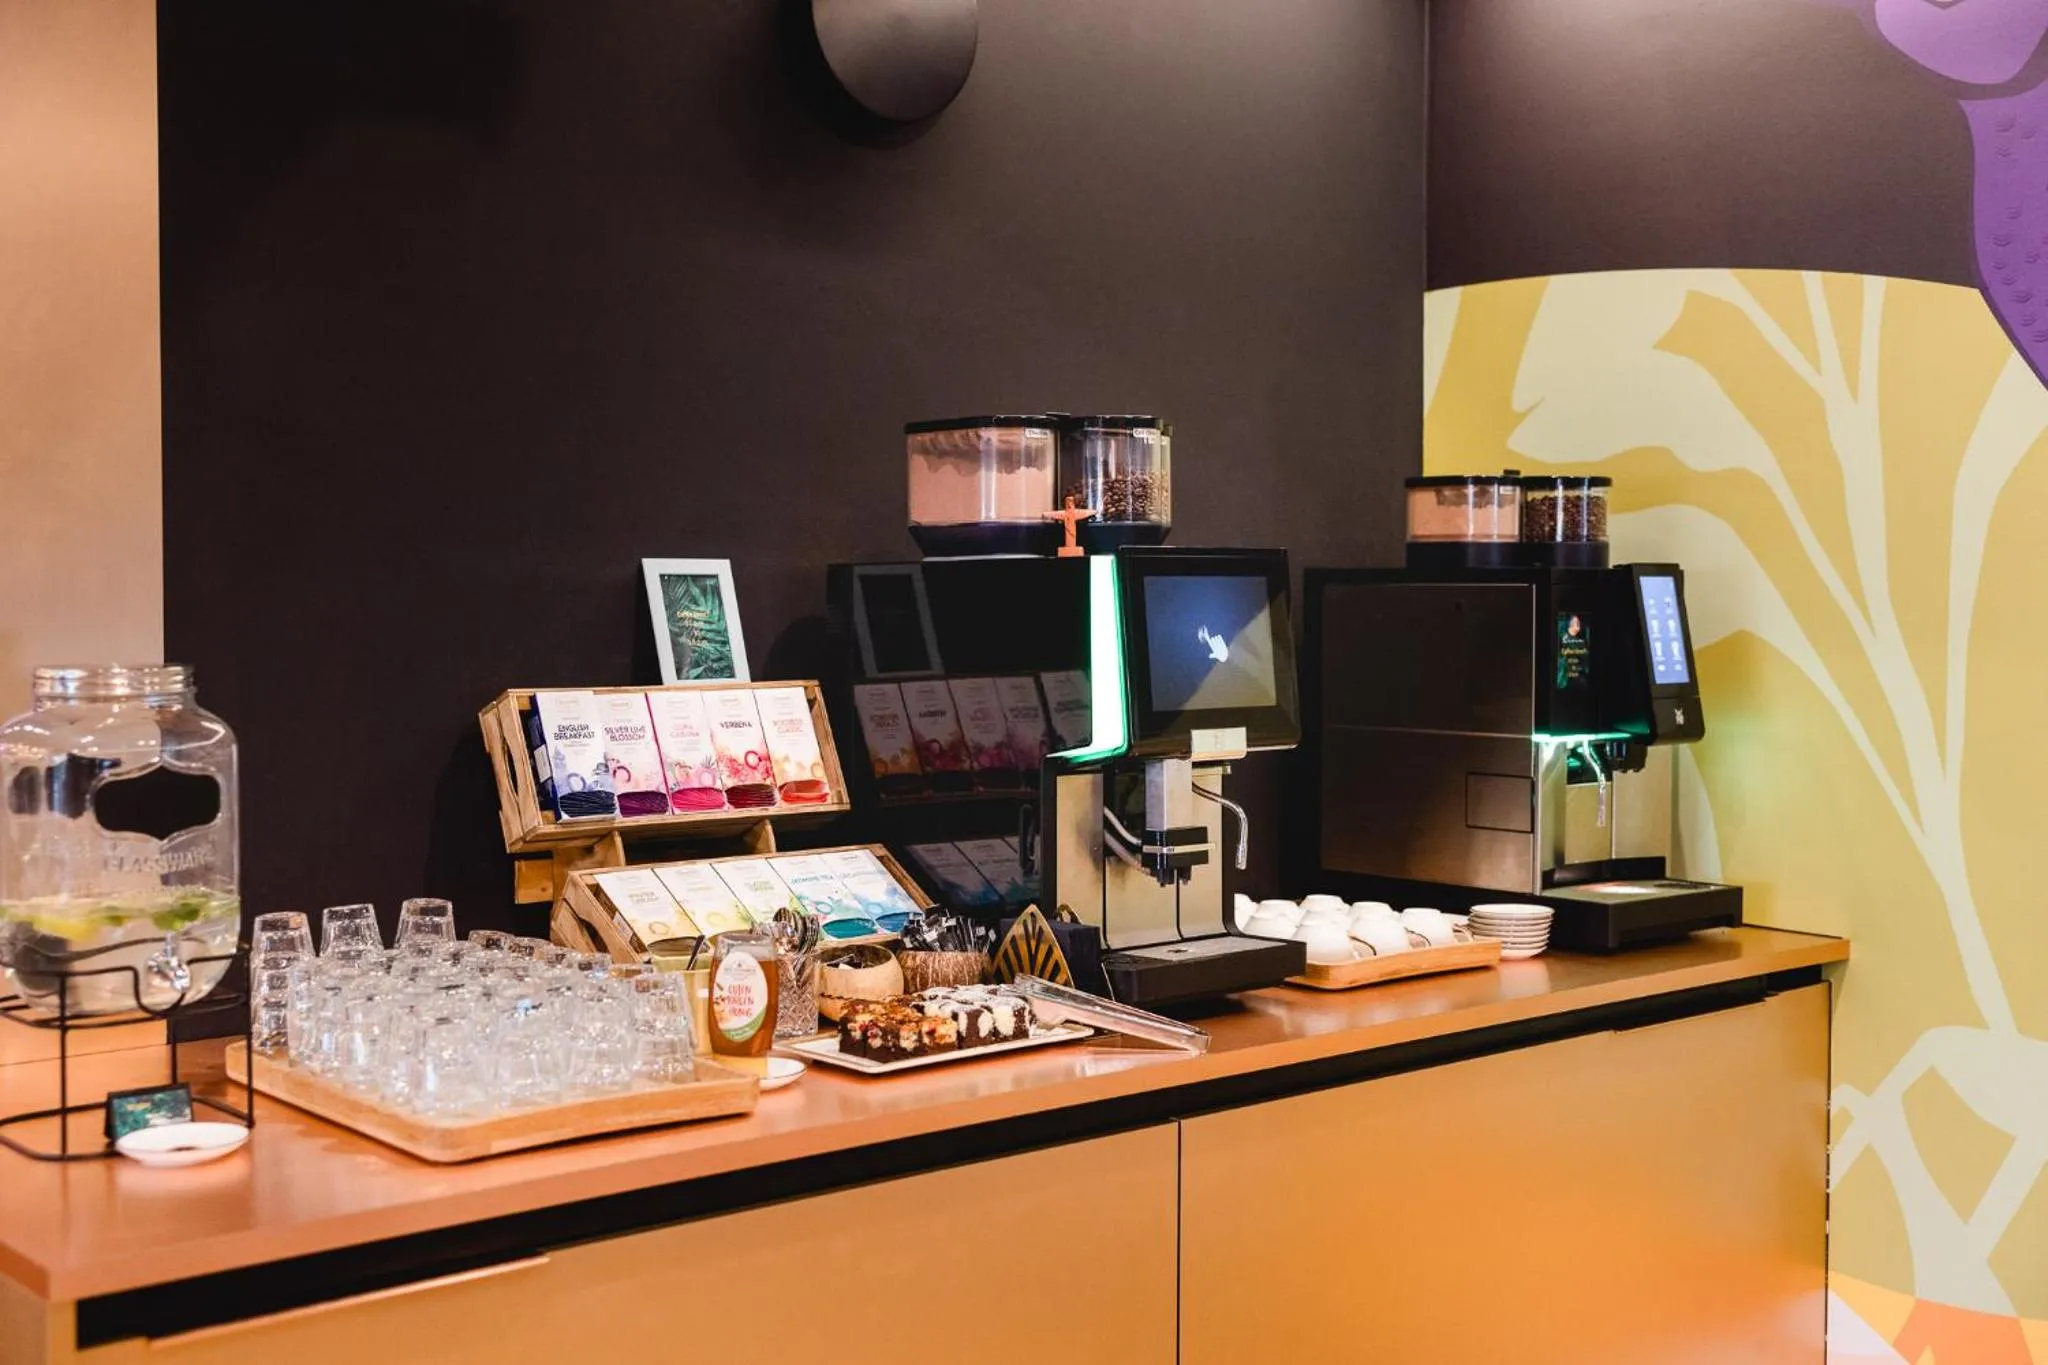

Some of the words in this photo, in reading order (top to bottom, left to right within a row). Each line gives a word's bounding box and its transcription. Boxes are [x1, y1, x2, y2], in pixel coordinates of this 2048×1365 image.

[557, 724, 590, 732] ENGLISH
[720, 720, 752, 728] VERBENA
[554, 732, 595, 740] BREAKFAST
